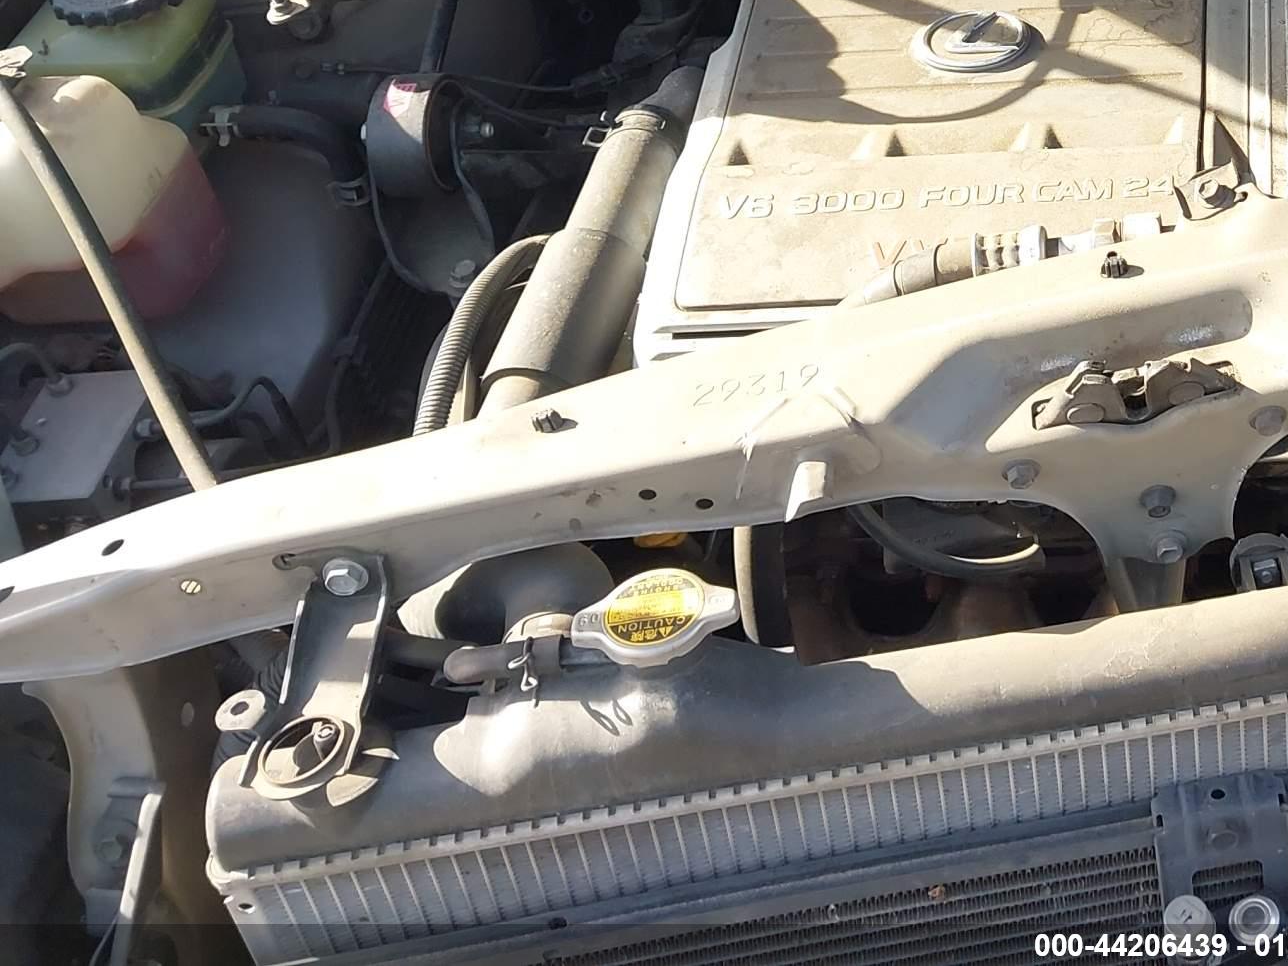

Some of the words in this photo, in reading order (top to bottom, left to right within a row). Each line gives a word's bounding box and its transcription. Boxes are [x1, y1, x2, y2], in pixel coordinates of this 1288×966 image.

[718, 192, 776, 220] V6
[792, 187, 905, 216] 3000
[918, 181, 1025, 210] FOUR
[1032, 176, 1114, 203] CAM
[617, 616, 686, 634] CAUTION
